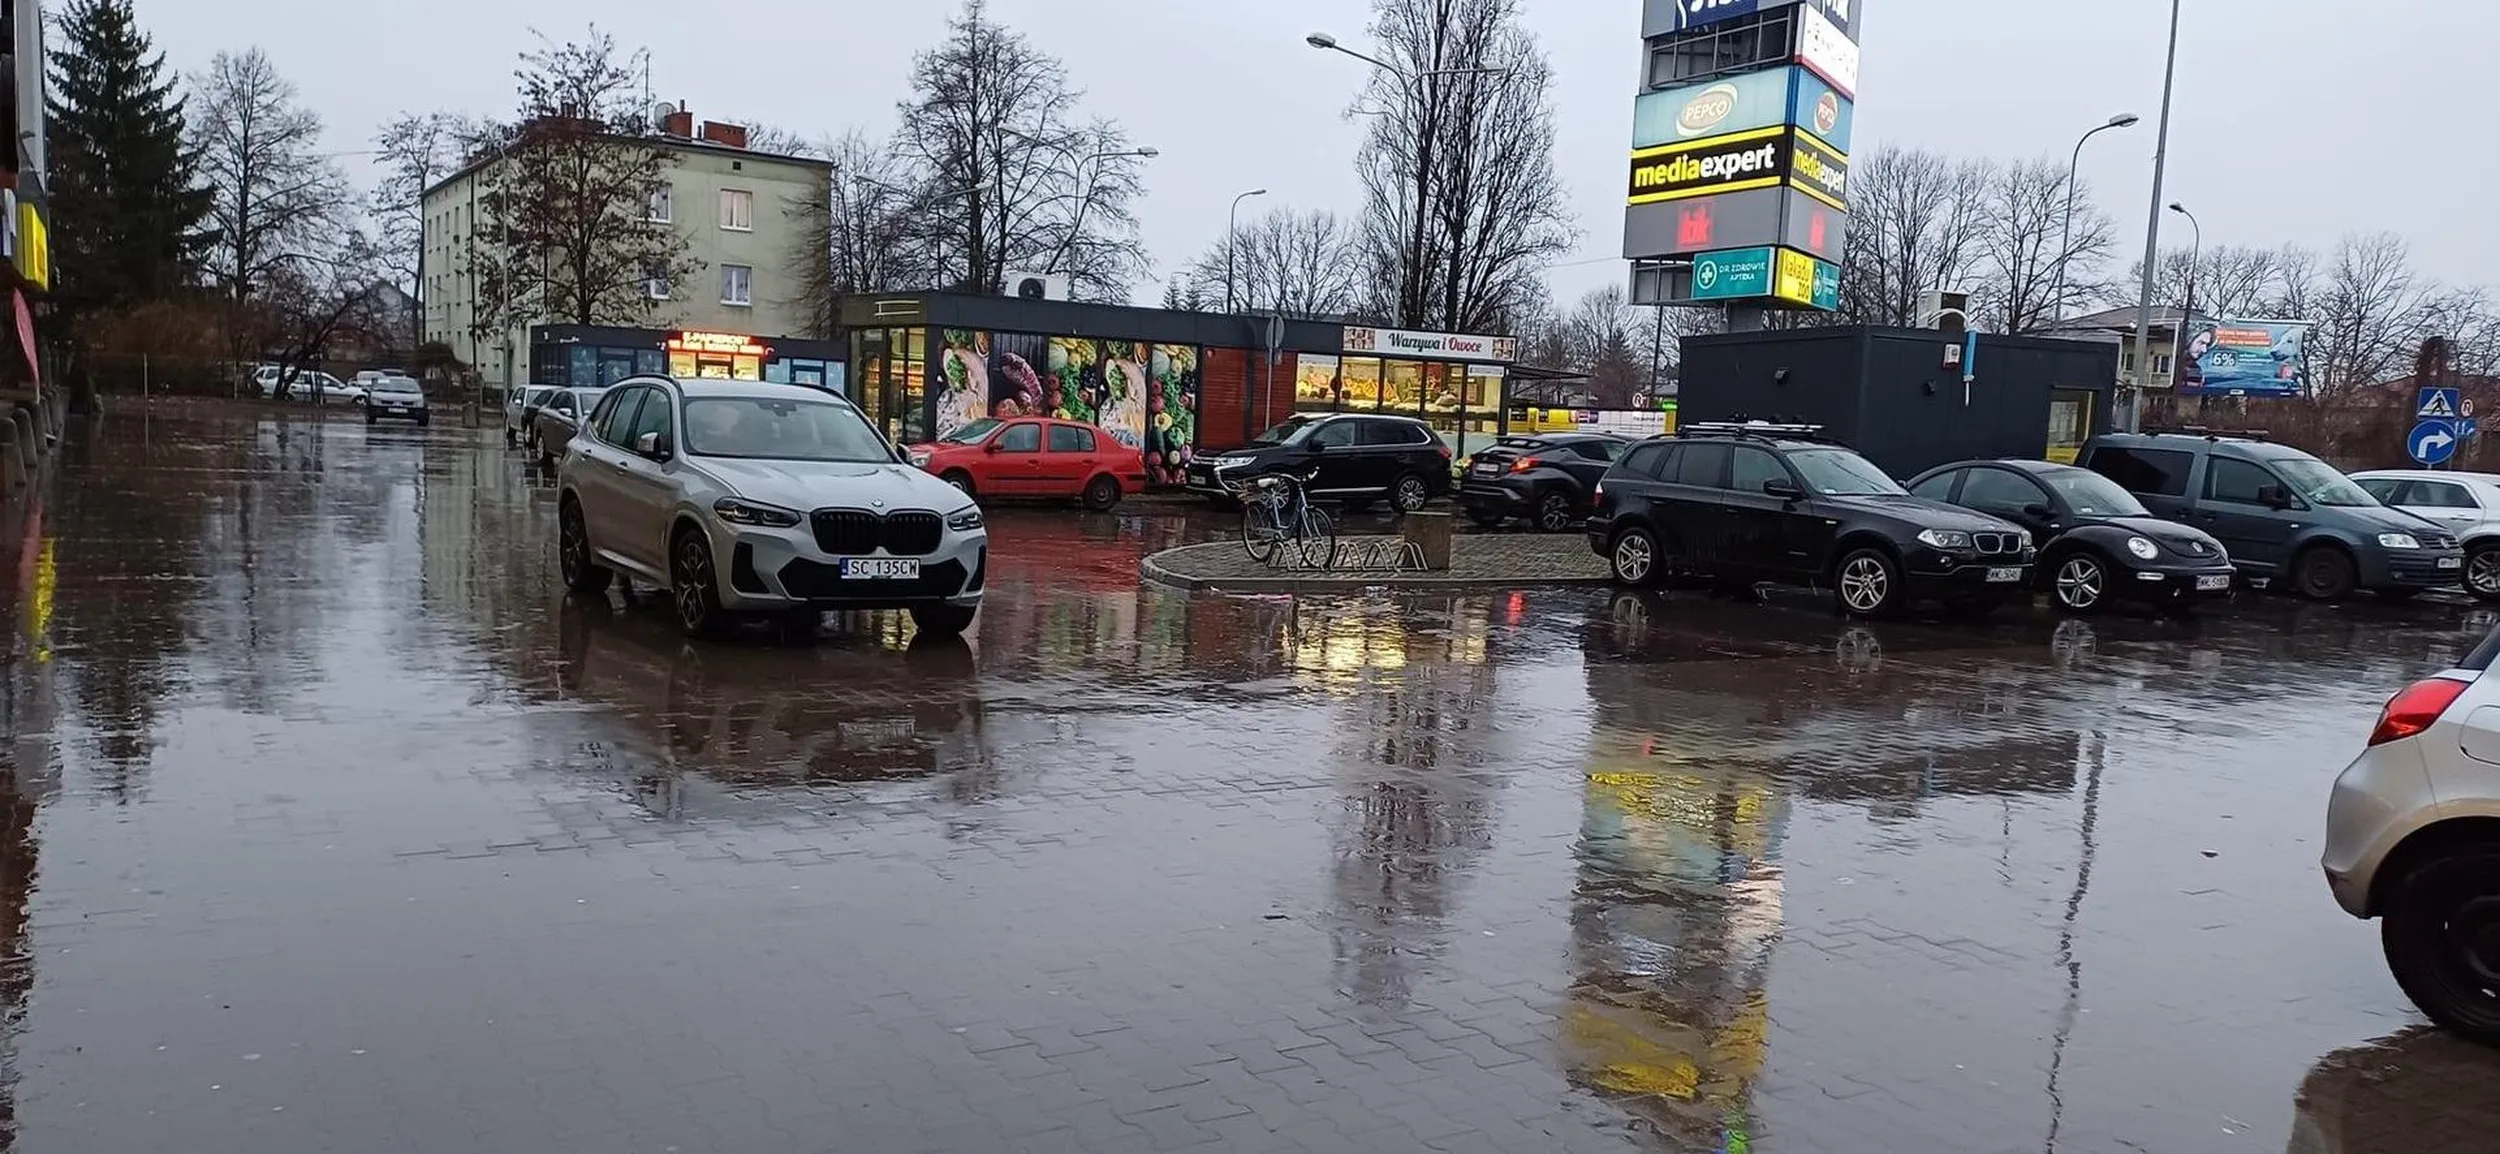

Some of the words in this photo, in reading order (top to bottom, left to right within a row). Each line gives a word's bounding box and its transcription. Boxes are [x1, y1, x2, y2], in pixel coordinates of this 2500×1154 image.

[1685, 100, 1728, 121] PEPCO
[1388, 332, 1440, 352] Warzywa
[1448, 337, 1483, 353] Owoce
[2213, 352, 2235, 366] 6%
[851, 561, 869, 574] SC
[876, 561, 917, 575] 135CW
